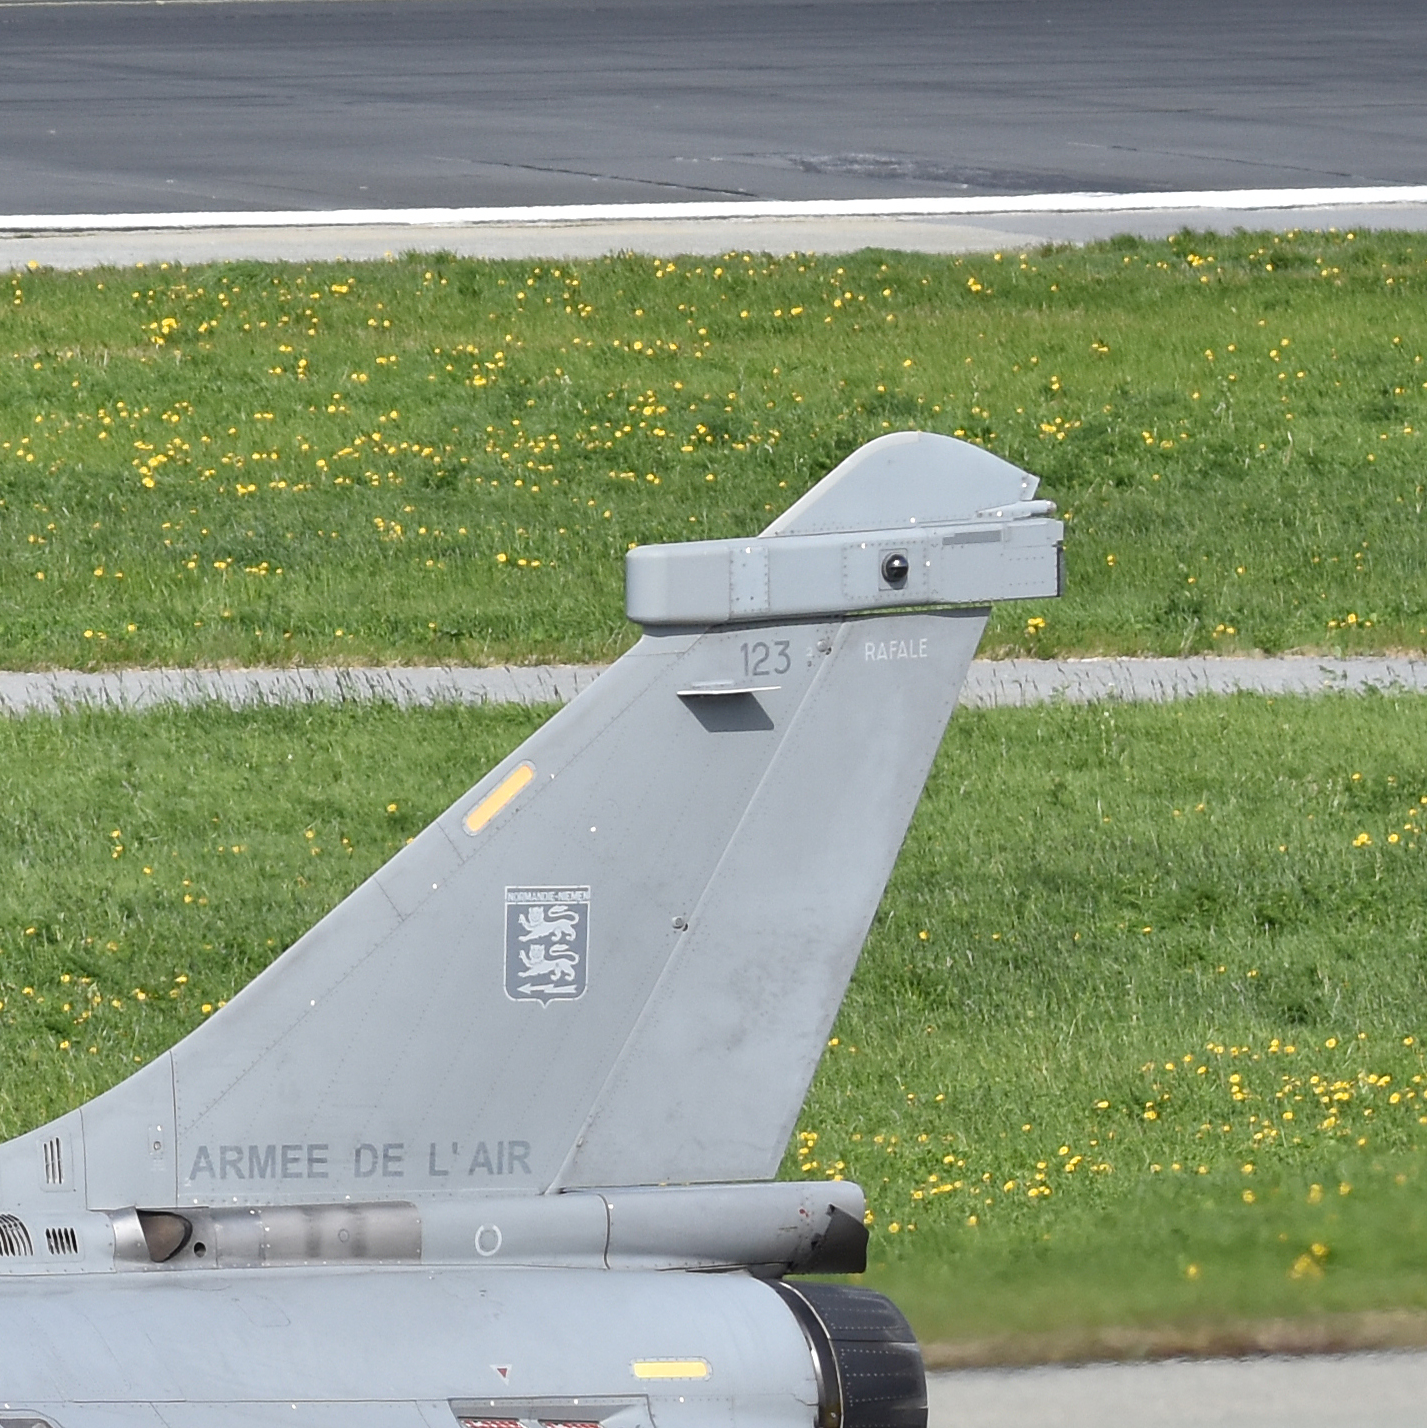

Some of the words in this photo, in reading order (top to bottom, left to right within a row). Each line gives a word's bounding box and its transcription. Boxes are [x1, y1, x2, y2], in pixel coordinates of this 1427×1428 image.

[740, 640, 791, 676] 123
[865, 638, 928, 661] RAFALE
[189, 1144, 329, 1180] ARMEE
[354, 1142, 405, 1178] DE
